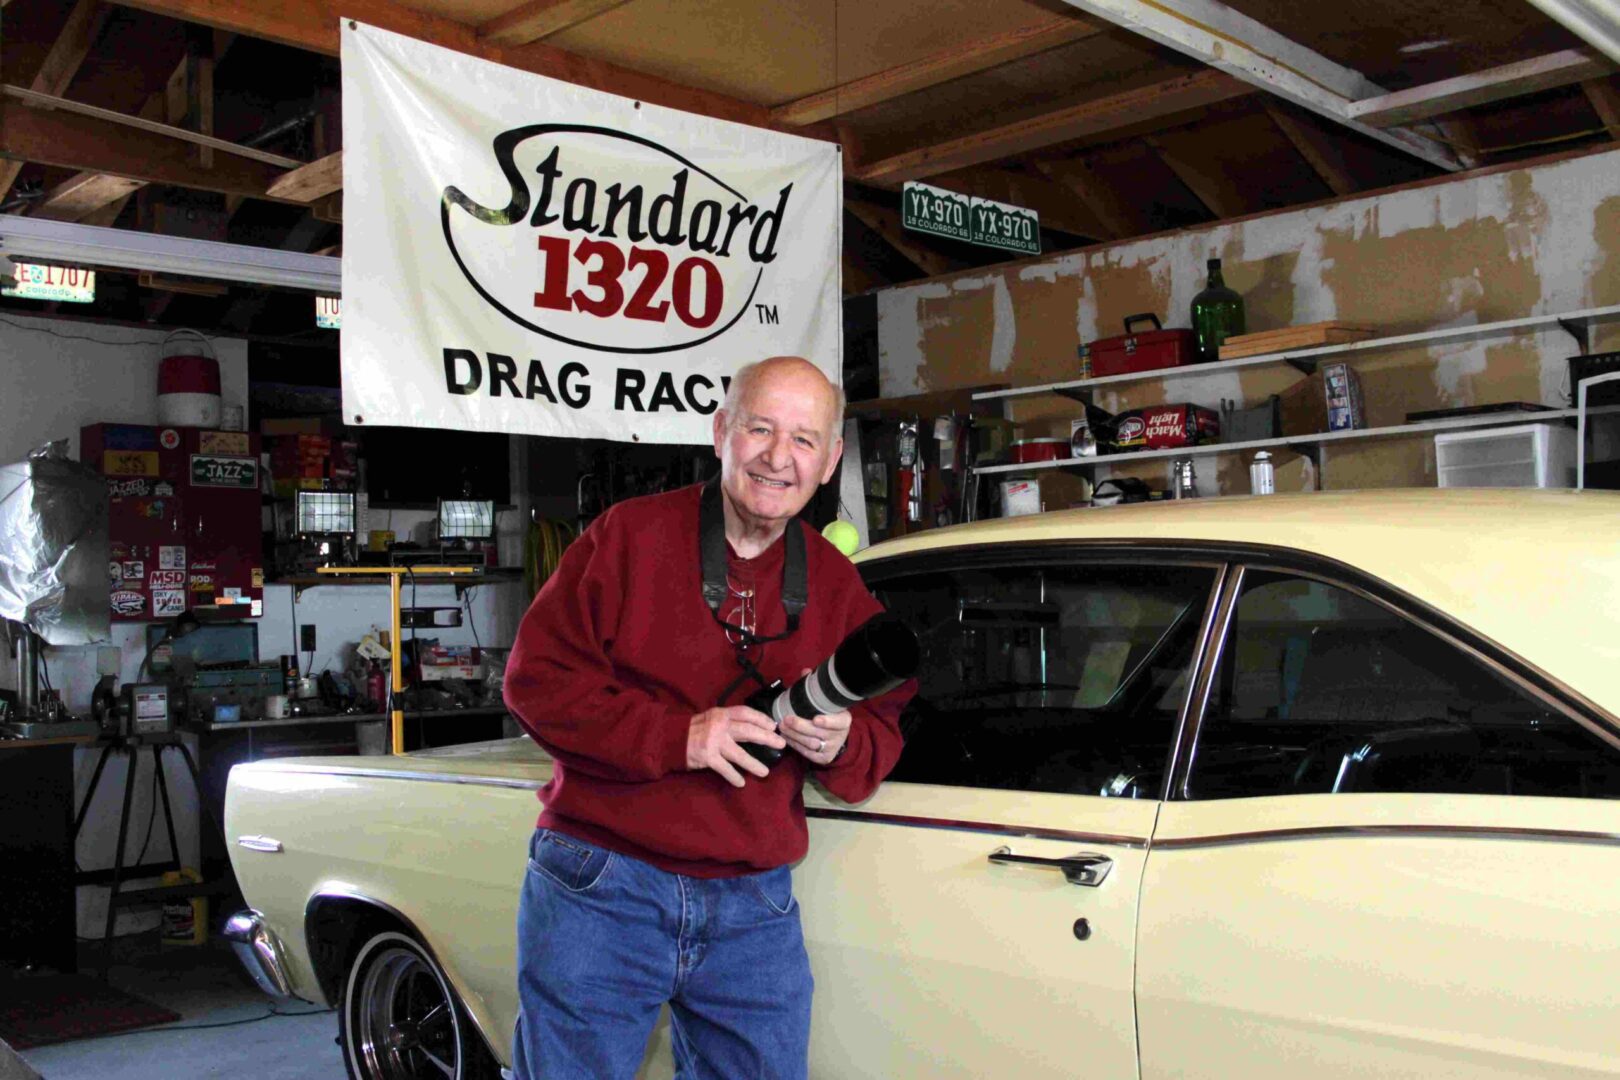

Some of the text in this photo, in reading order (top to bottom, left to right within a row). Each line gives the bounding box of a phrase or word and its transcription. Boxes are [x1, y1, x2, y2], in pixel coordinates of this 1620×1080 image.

[441, 123, 793, 264] Standard
[918, 218, 957, 234] COLORADO
[985, 235, 1027, 249] COLORADO
[534, 236, 724, 329] 1320
[755, 304, 780, 325] TM
[443, 348, 592, 409] DRAG
[1149, 412, 1180, 426] Light
[1145, 424, 1183, 438] Match
[206, 464, 242, 479] JAZZ
[151, 571, 185, 585] MSD
